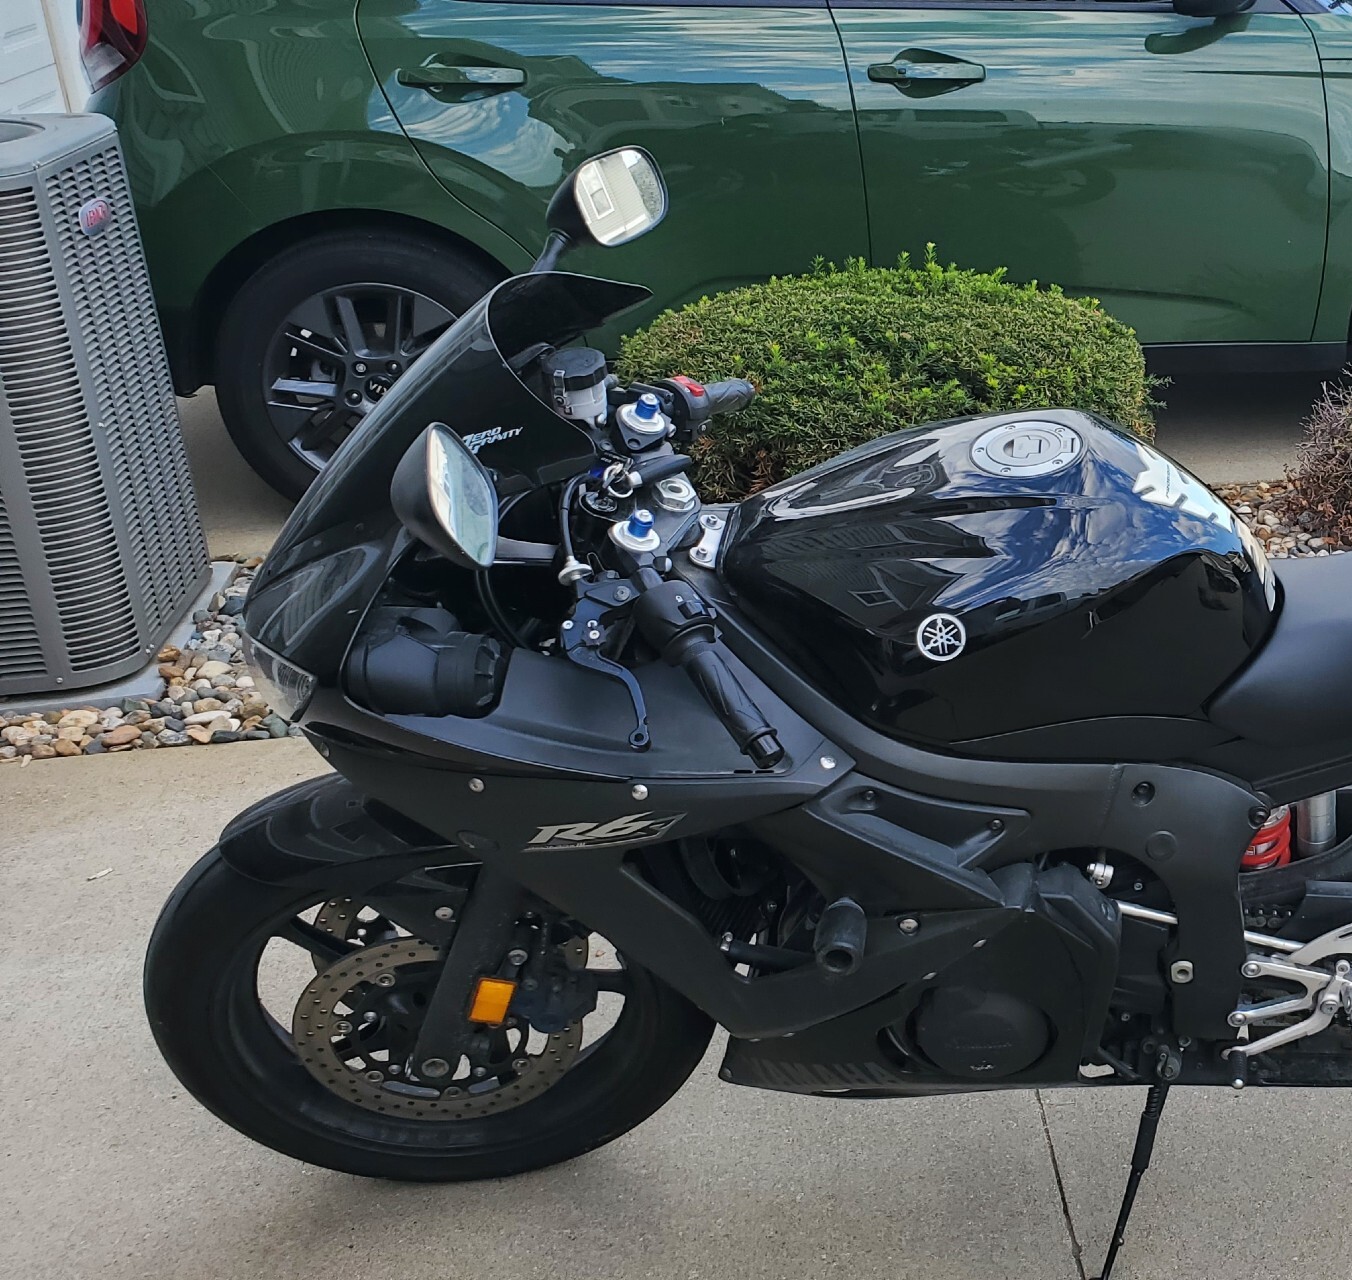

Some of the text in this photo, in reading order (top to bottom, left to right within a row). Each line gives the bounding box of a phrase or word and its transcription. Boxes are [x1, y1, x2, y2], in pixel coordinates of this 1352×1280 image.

[462, 427, 502, 448] ZERO
[469, 427, 524, 454] GRAVITY
[527, 811, 656, 844] R6
[740, 1055, 905, 1086] YAMAHA
